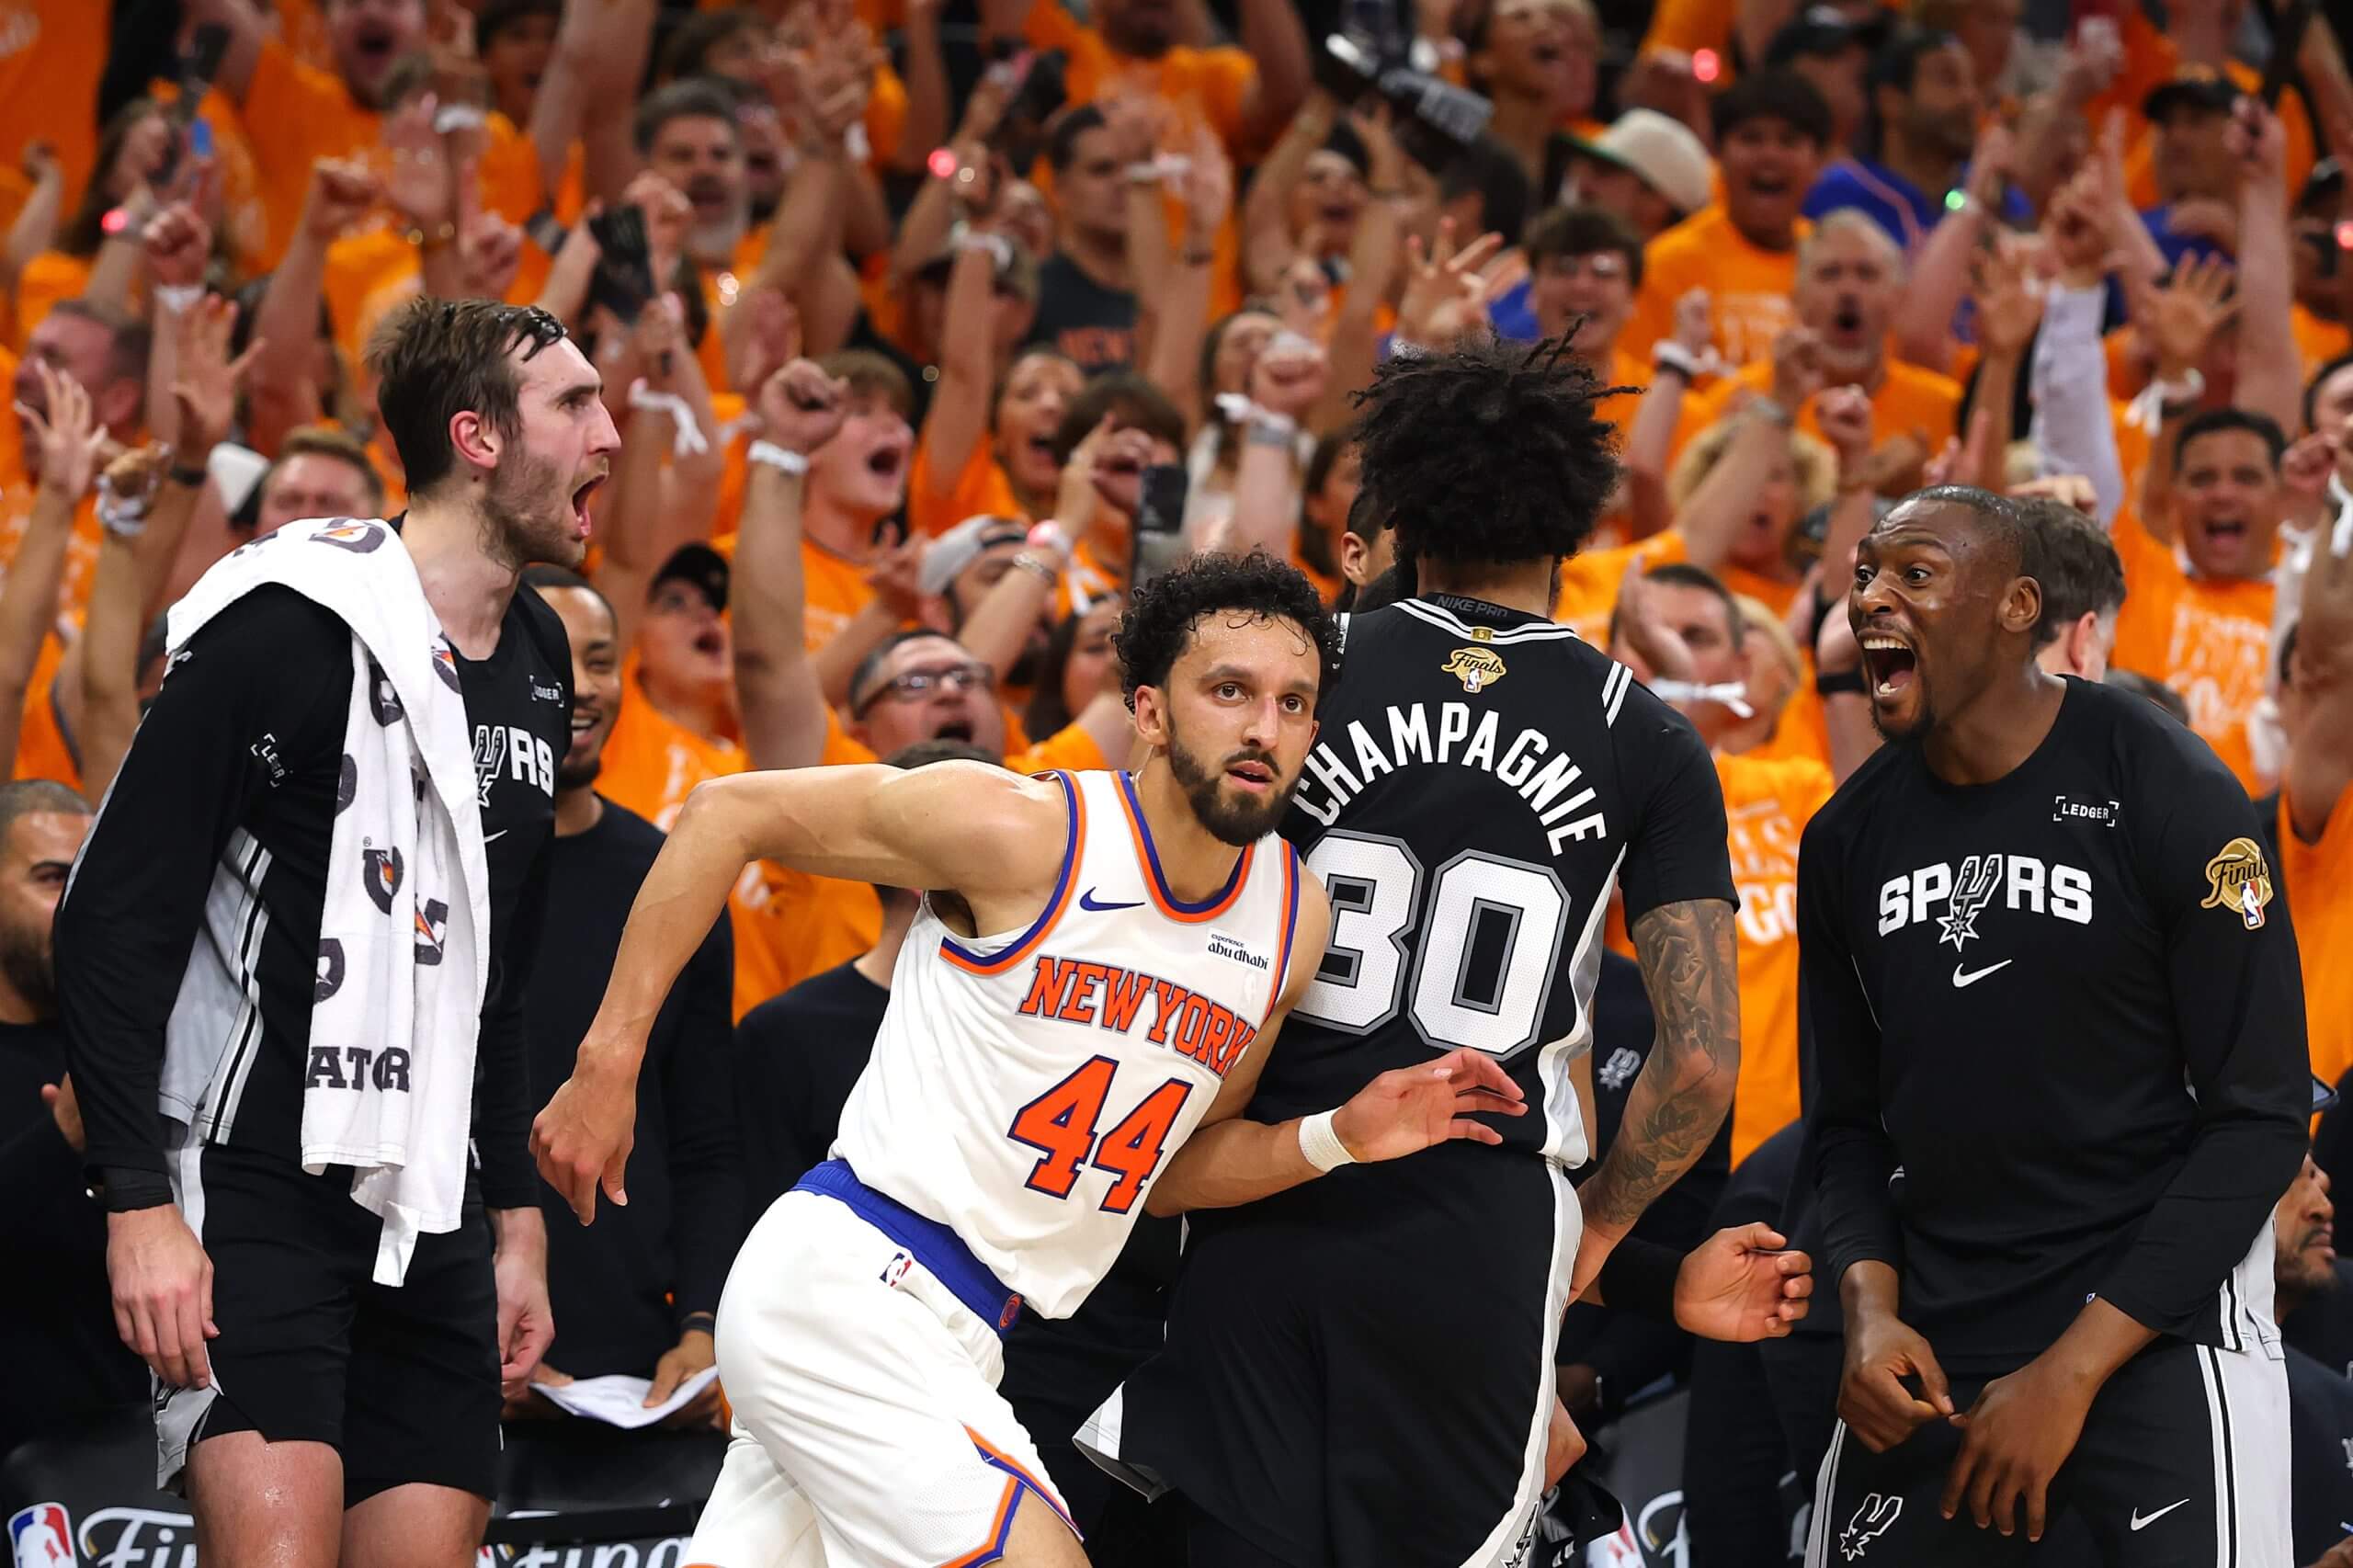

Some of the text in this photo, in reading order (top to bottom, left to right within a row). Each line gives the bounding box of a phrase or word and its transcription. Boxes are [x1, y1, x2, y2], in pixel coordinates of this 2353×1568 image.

[1436, 596, 1474, 613] NIKE
[1443, 651, 1504, 674] Finals
[1290, 702, 1608, 857] CHAMPAGNIE
[2061, 802, 2109, 820] LEDGER
[1878, 853, 2093, 953] SPURS
[2205, 851, 2268, 905] Final
[1208, 942, 1269, 971] abu dhabi
[1287, 828, 1572, 1061] 30
[1015, 954, 1256, 1082] NEW YORK
[1006, 1054, 1194, 1215] 44
